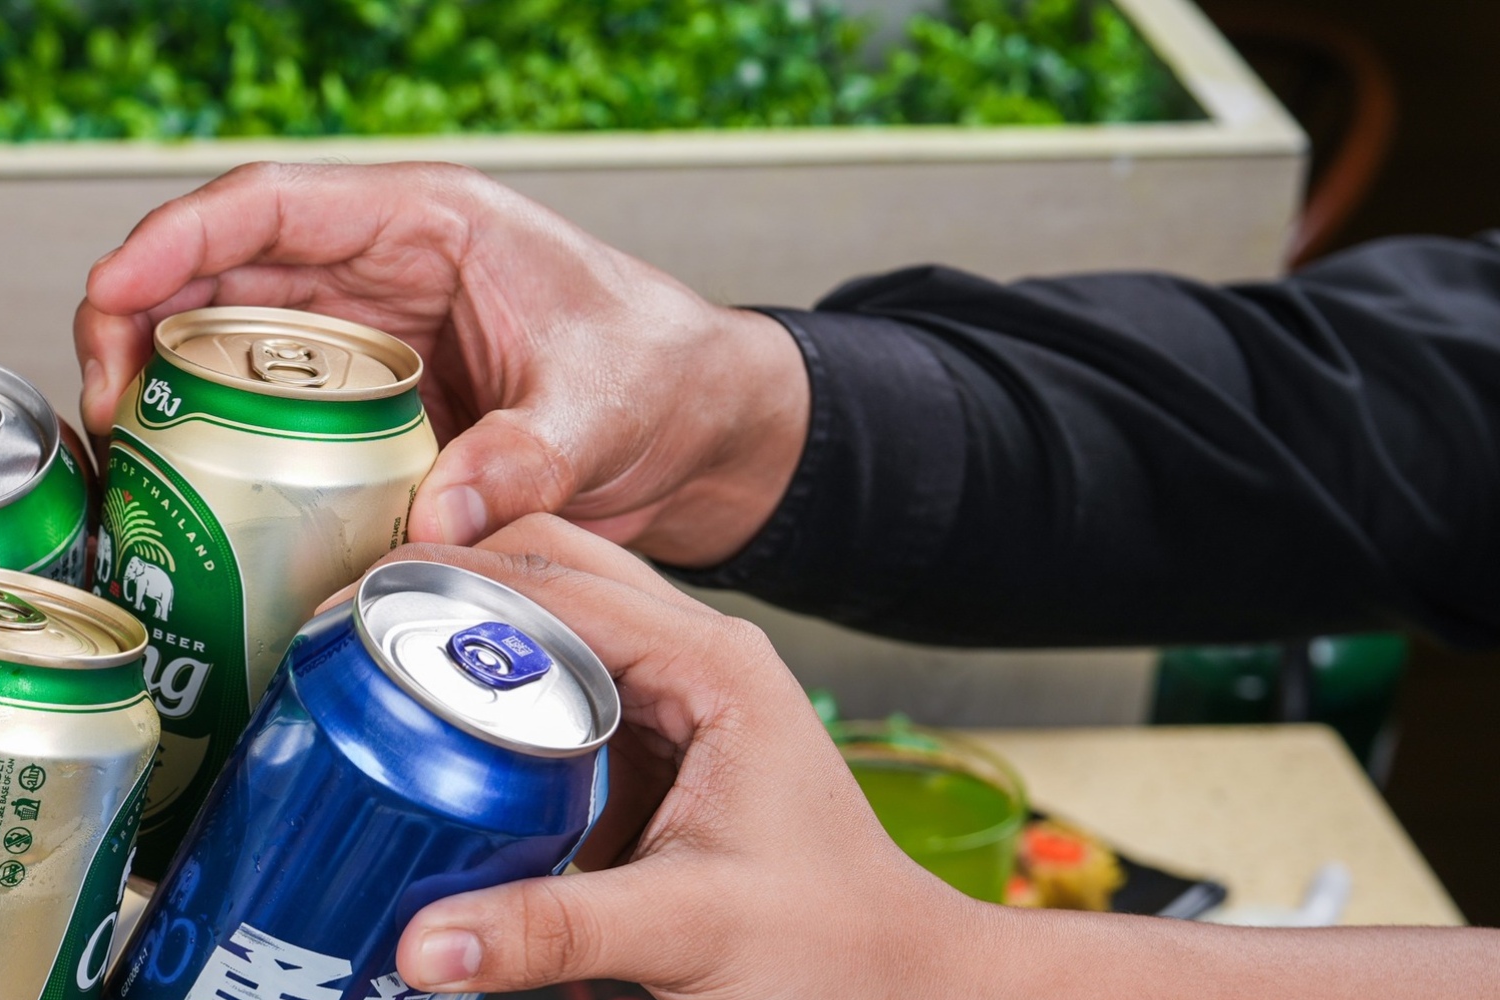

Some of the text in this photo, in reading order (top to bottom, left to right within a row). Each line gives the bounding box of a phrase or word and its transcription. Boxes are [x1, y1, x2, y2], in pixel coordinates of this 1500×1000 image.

[122, 464, 136, 477] OF
[142, 476, 216, 572] THAILAND
[153, 627, 206, 653] BEER
[6, 758, 15, 774] CAN
[4, 775, 11, 785] OF
[0, 786, 10, 804] BASE
[120, 947, 149, 998] G21006-1-1
